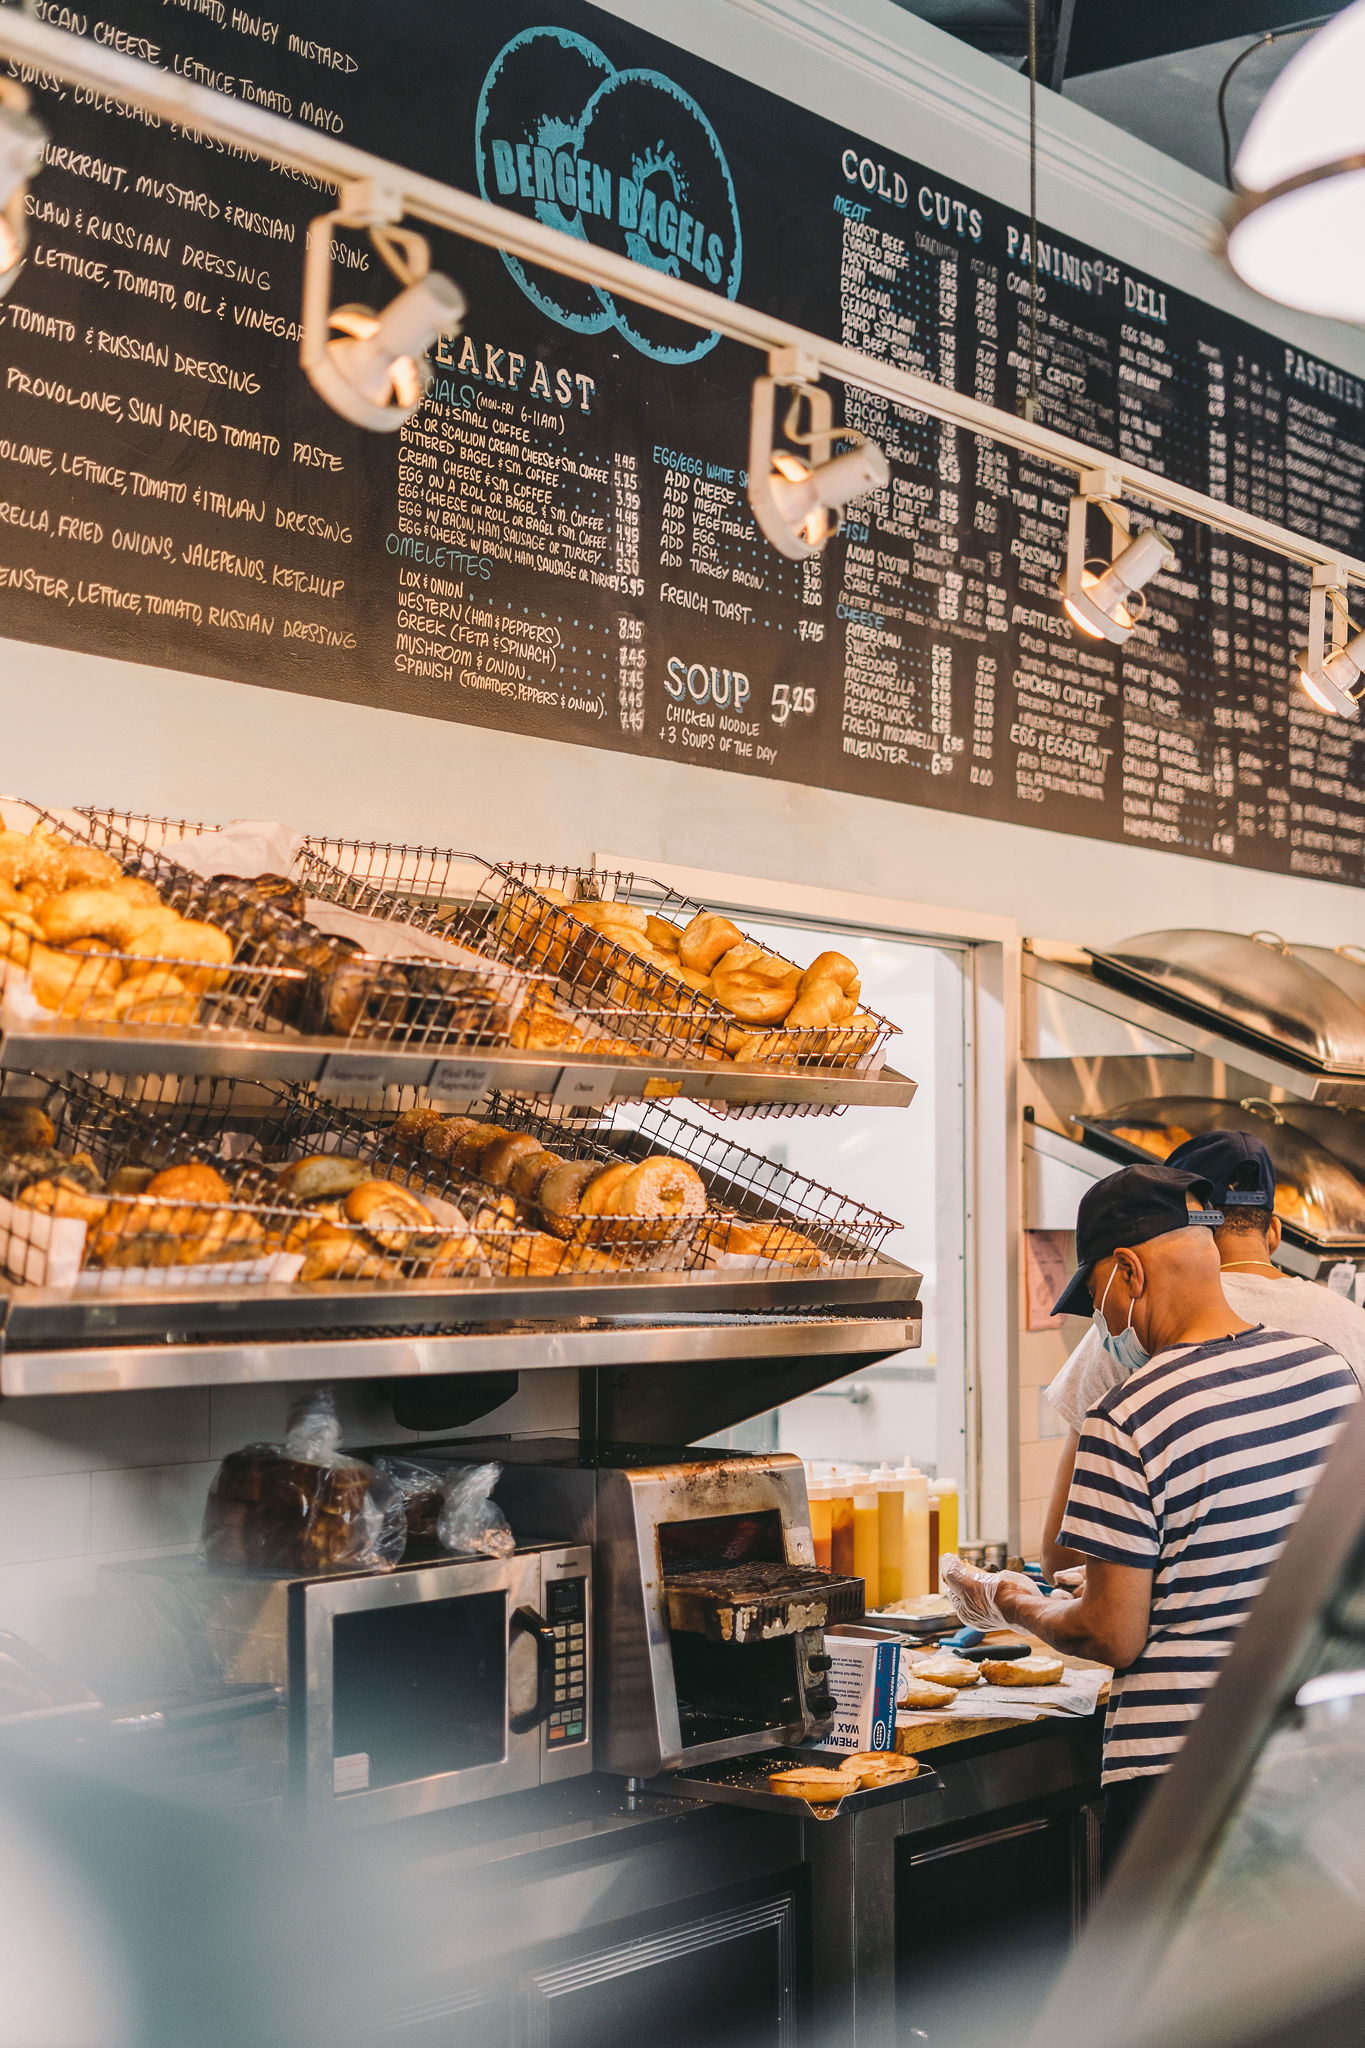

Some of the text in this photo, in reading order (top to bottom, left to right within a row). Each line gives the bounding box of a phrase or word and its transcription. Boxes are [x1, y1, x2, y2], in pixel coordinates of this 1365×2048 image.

[231, 8, 359, 73] HONEY MUSTARD
[239, 78, 293, 119] TOMATO,
[300, 101, 345, 134] MAYO
[136, 175, 296, 243] MUSTARD RUSSIAN
[491, 139, 725, 285] BERGEN BAGELS
[833, 194, 872, 223] MEAT
[841, 148, 984, 243] COLD CUTS
[86, 215, 171, 258] RUSSIAN
[182, 244, 272, 291] DRESSING
[843, 217, 881, 244] ROAST
[881, 232, 906, 254] BEEF
[35, 246, 212, 315] LETTUCE, TOMATO, OIL
[840, 260, 867, 286] HAM
[841, 246, 897, 283] PASTRAMI
[1006, 225, 1093, 296] PANINIS
[1123, 275, 1169, 326] DELI
[840, 276, 892, 311] BOLOGNA
[840, 293, 917, 336] GENOA SALAMI
[8, 305, 261, 395] TOMATO RUSSIAN DRESSING
[873, 322, 911, 349] SALAMI
[424, 332, 598, 415] EAKFAST
[1284, 347, 1364, 410] PASTRIES
[7, 368, 345, 473] PROVOLONE, SUN DRIED TOMATO PASTE
[452, 407, 531, 443] SMALL COFFEE
[476, 391, 565, 436] (MON-FRI 6-11AM)
[844, 399, 888, 425] BACON
[844, 414, 901, 444] SAUSAGE
[400, 427, 495, 469] BUTTERED BAGEL
[441, 423, 610, 485] SCALLION CREAM COFFEE
[652, 444, 704, 477] EGG/EGG
[706, 461, 736, 485] WHITE
[884, 442, 921, 466] BACON
[398, 446, 553, 505] CREAM CHEESE COFFEE
[664, 469, 690, 489] ADD
[692, 477, 737, 505] CHEESE
[892, 477, 934, 501] CHICKEN
[129, 471, 188, 505] TOMATO
[203, 490, 266, 524] ITALIAN
[276, 507, 354, 545] DRESSING
[398, 464, 605, 532] EGG ROLL BAGEL COFFEE
[398, 482, 608, 550] EGG CHEESE ROLL BAGEL COFFEE
[663, 486, 728, 521] ADD MEAT
[892, 493, 929, 516] CUTLET
[398, 498, 602, 566] EGG SAUSAGE TURKEY
[661, 518, 716, 546] ADD EGG
[662, 501, 755, 541] ADD VEGETABLE
[836, 520, 870, 543] FISH
[846, 507, 921, 541] BBQ CHICKEN
[58, 515, 104, 545] FRIED
[111, 528, 178, 565] ONIONS,
[272, 564, 346, 600] KETCHUP
[385, 532, 494, 581] OMELETTES
[398, 515, 577, 580] EGG CHEESE SAUSAGE
[660, 533, 719, 563] ADD FISH
[1010, 538, 1062, 571] RUSSIAN
[399, 567, 464, 599] LOX ONION
[659, 550, 765, 591] ADD TURKEY BACON
[843, 574, 881, 597] SABLE
[844, 560, 875, 581] WHITE
[398, 591, 561, 649] WESTERN PEPPERS)
[659, 581, 753, 626] FRENCH TOAST
[836, 603, 886, 630] CHEESE
[1011, 604, 1074, 640] MEATLESS
[208, 606, 275, 637] RUSSIAN
[283, 620, 358, 650] DRESSING
[397, 608, 557, 673] GREEK (FETA SPINACH)
[844, 635, 882, 658] SWISS
[845, 621, 903, 650] AMERICAN
[396, 632, 526, 681] MUSHROOM ONION
[845, 650, 899, 679] CHEDDAR
[394, 653, 454, 682] SPANISH
[518, 682, 560, 706] PEPPERS
[663, 655, 818, 724] SOUP 5.25
[843, 665, 916, 697] MOZZARELLA
[843, 679, 912, 710] PROVOLONE
[1012, 669, 1106, 713] CHICKEN CUTLET
[666, 703, 760, 737] CHICKEN NOODLE
[841, 713, 881, 739] FRESH
[681, 726, 778, 767] SOUPS DAY
[842, 736, 911, 765] MUENSTER
[1009, 723, 1115, 773] EGG EGGPLANT
[837, 1722, 860, 1735] WAX
